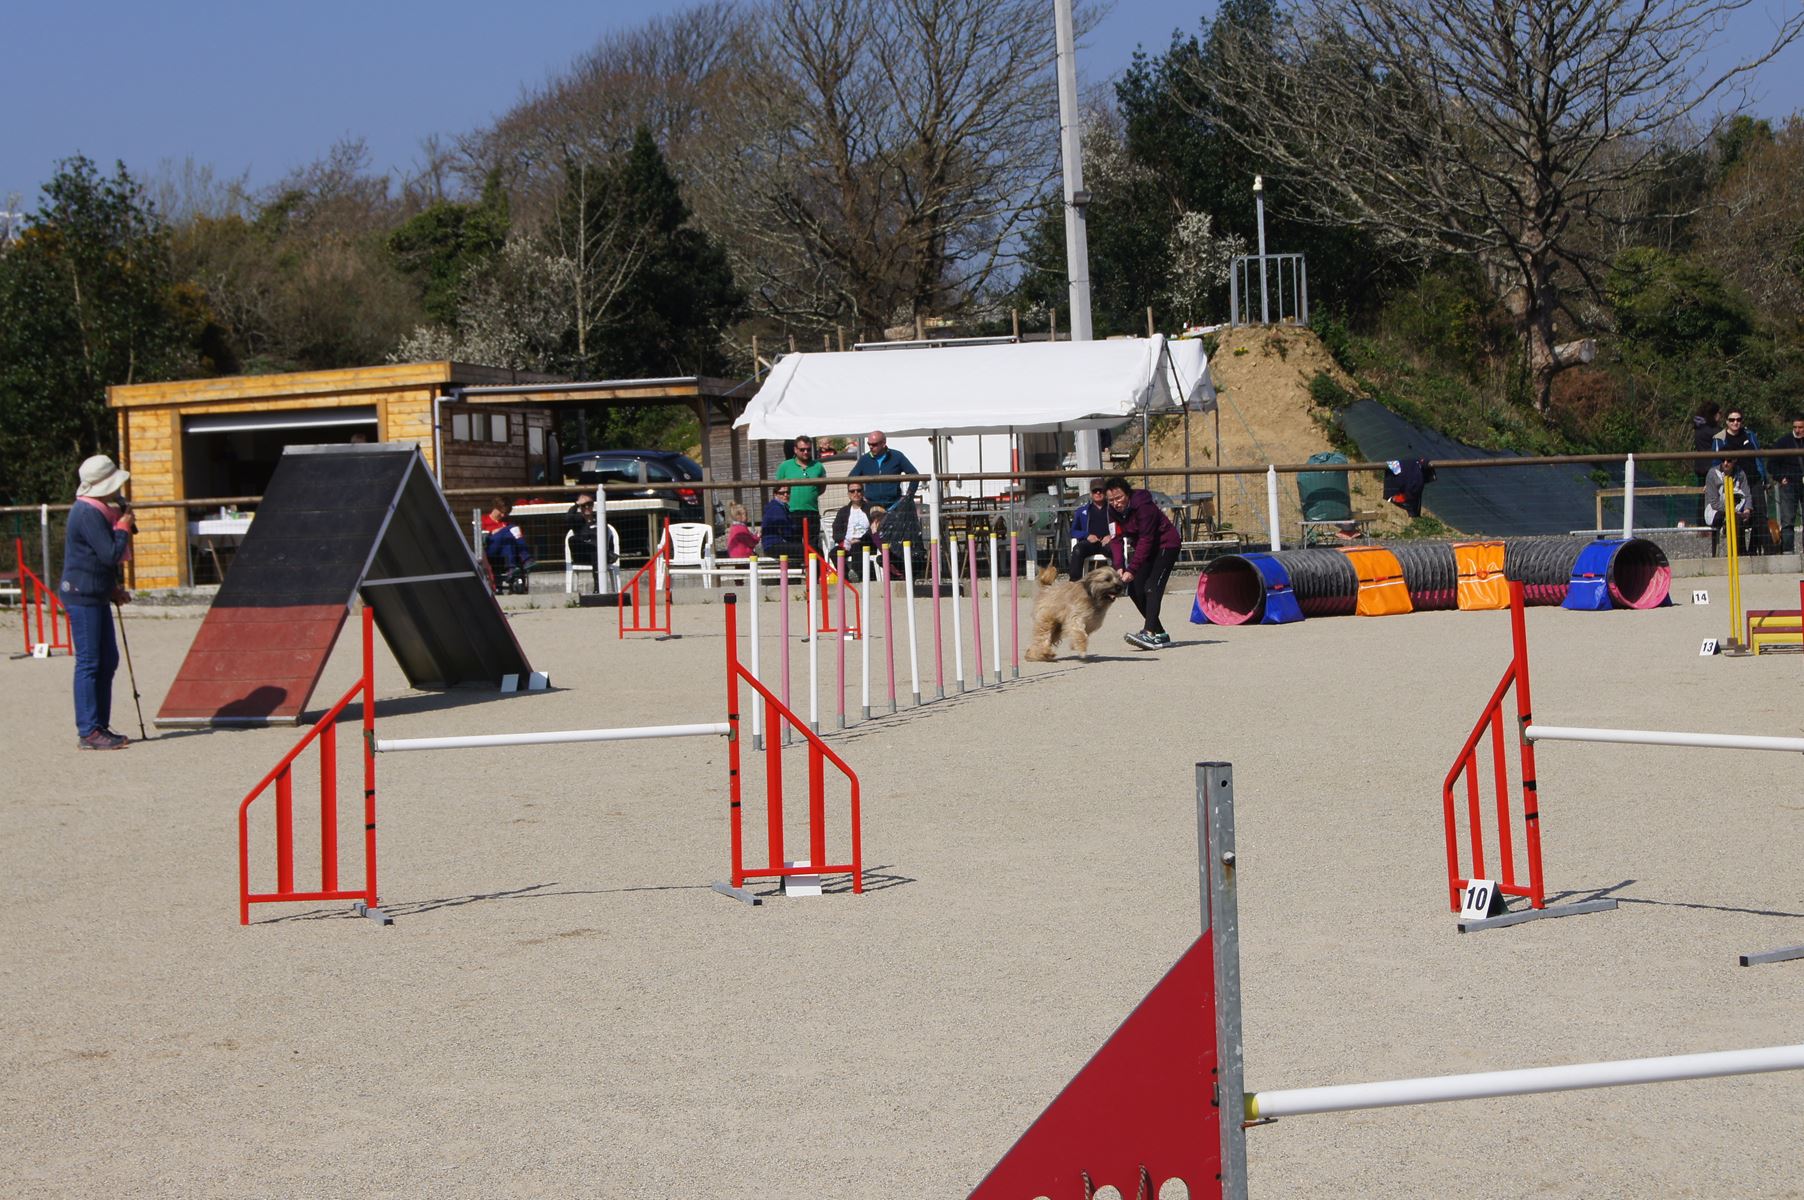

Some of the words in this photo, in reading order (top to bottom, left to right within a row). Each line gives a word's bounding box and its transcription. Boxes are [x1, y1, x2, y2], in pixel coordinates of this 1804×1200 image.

[1695, 593, 1707, 601] 14
[1703, 642, 1714, 652] 13
[1466, 886, 1488, 911] 10
